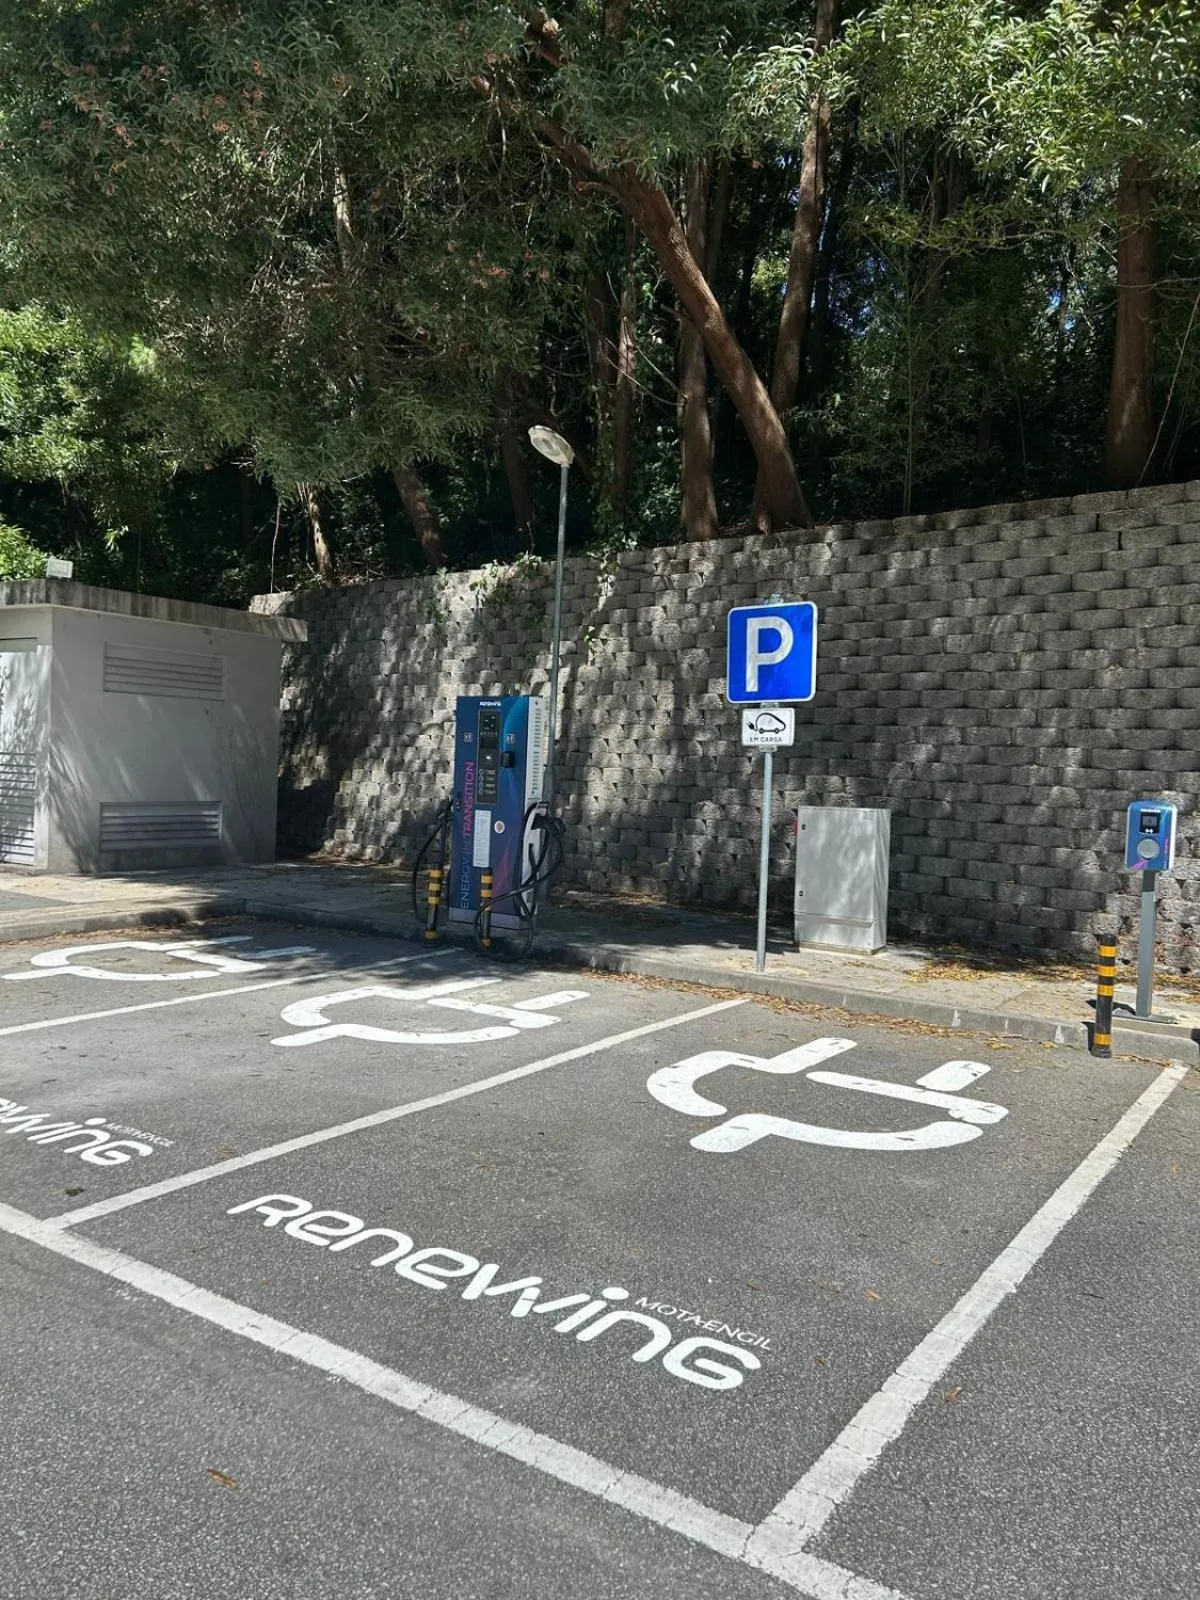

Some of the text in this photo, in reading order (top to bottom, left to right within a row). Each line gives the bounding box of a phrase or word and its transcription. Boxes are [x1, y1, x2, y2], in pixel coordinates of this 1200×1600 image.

[745, 616, 794, 693] P
[463, 761, 474, 838] TRANSITION
[460, 857, 471, 910] ENERGY
